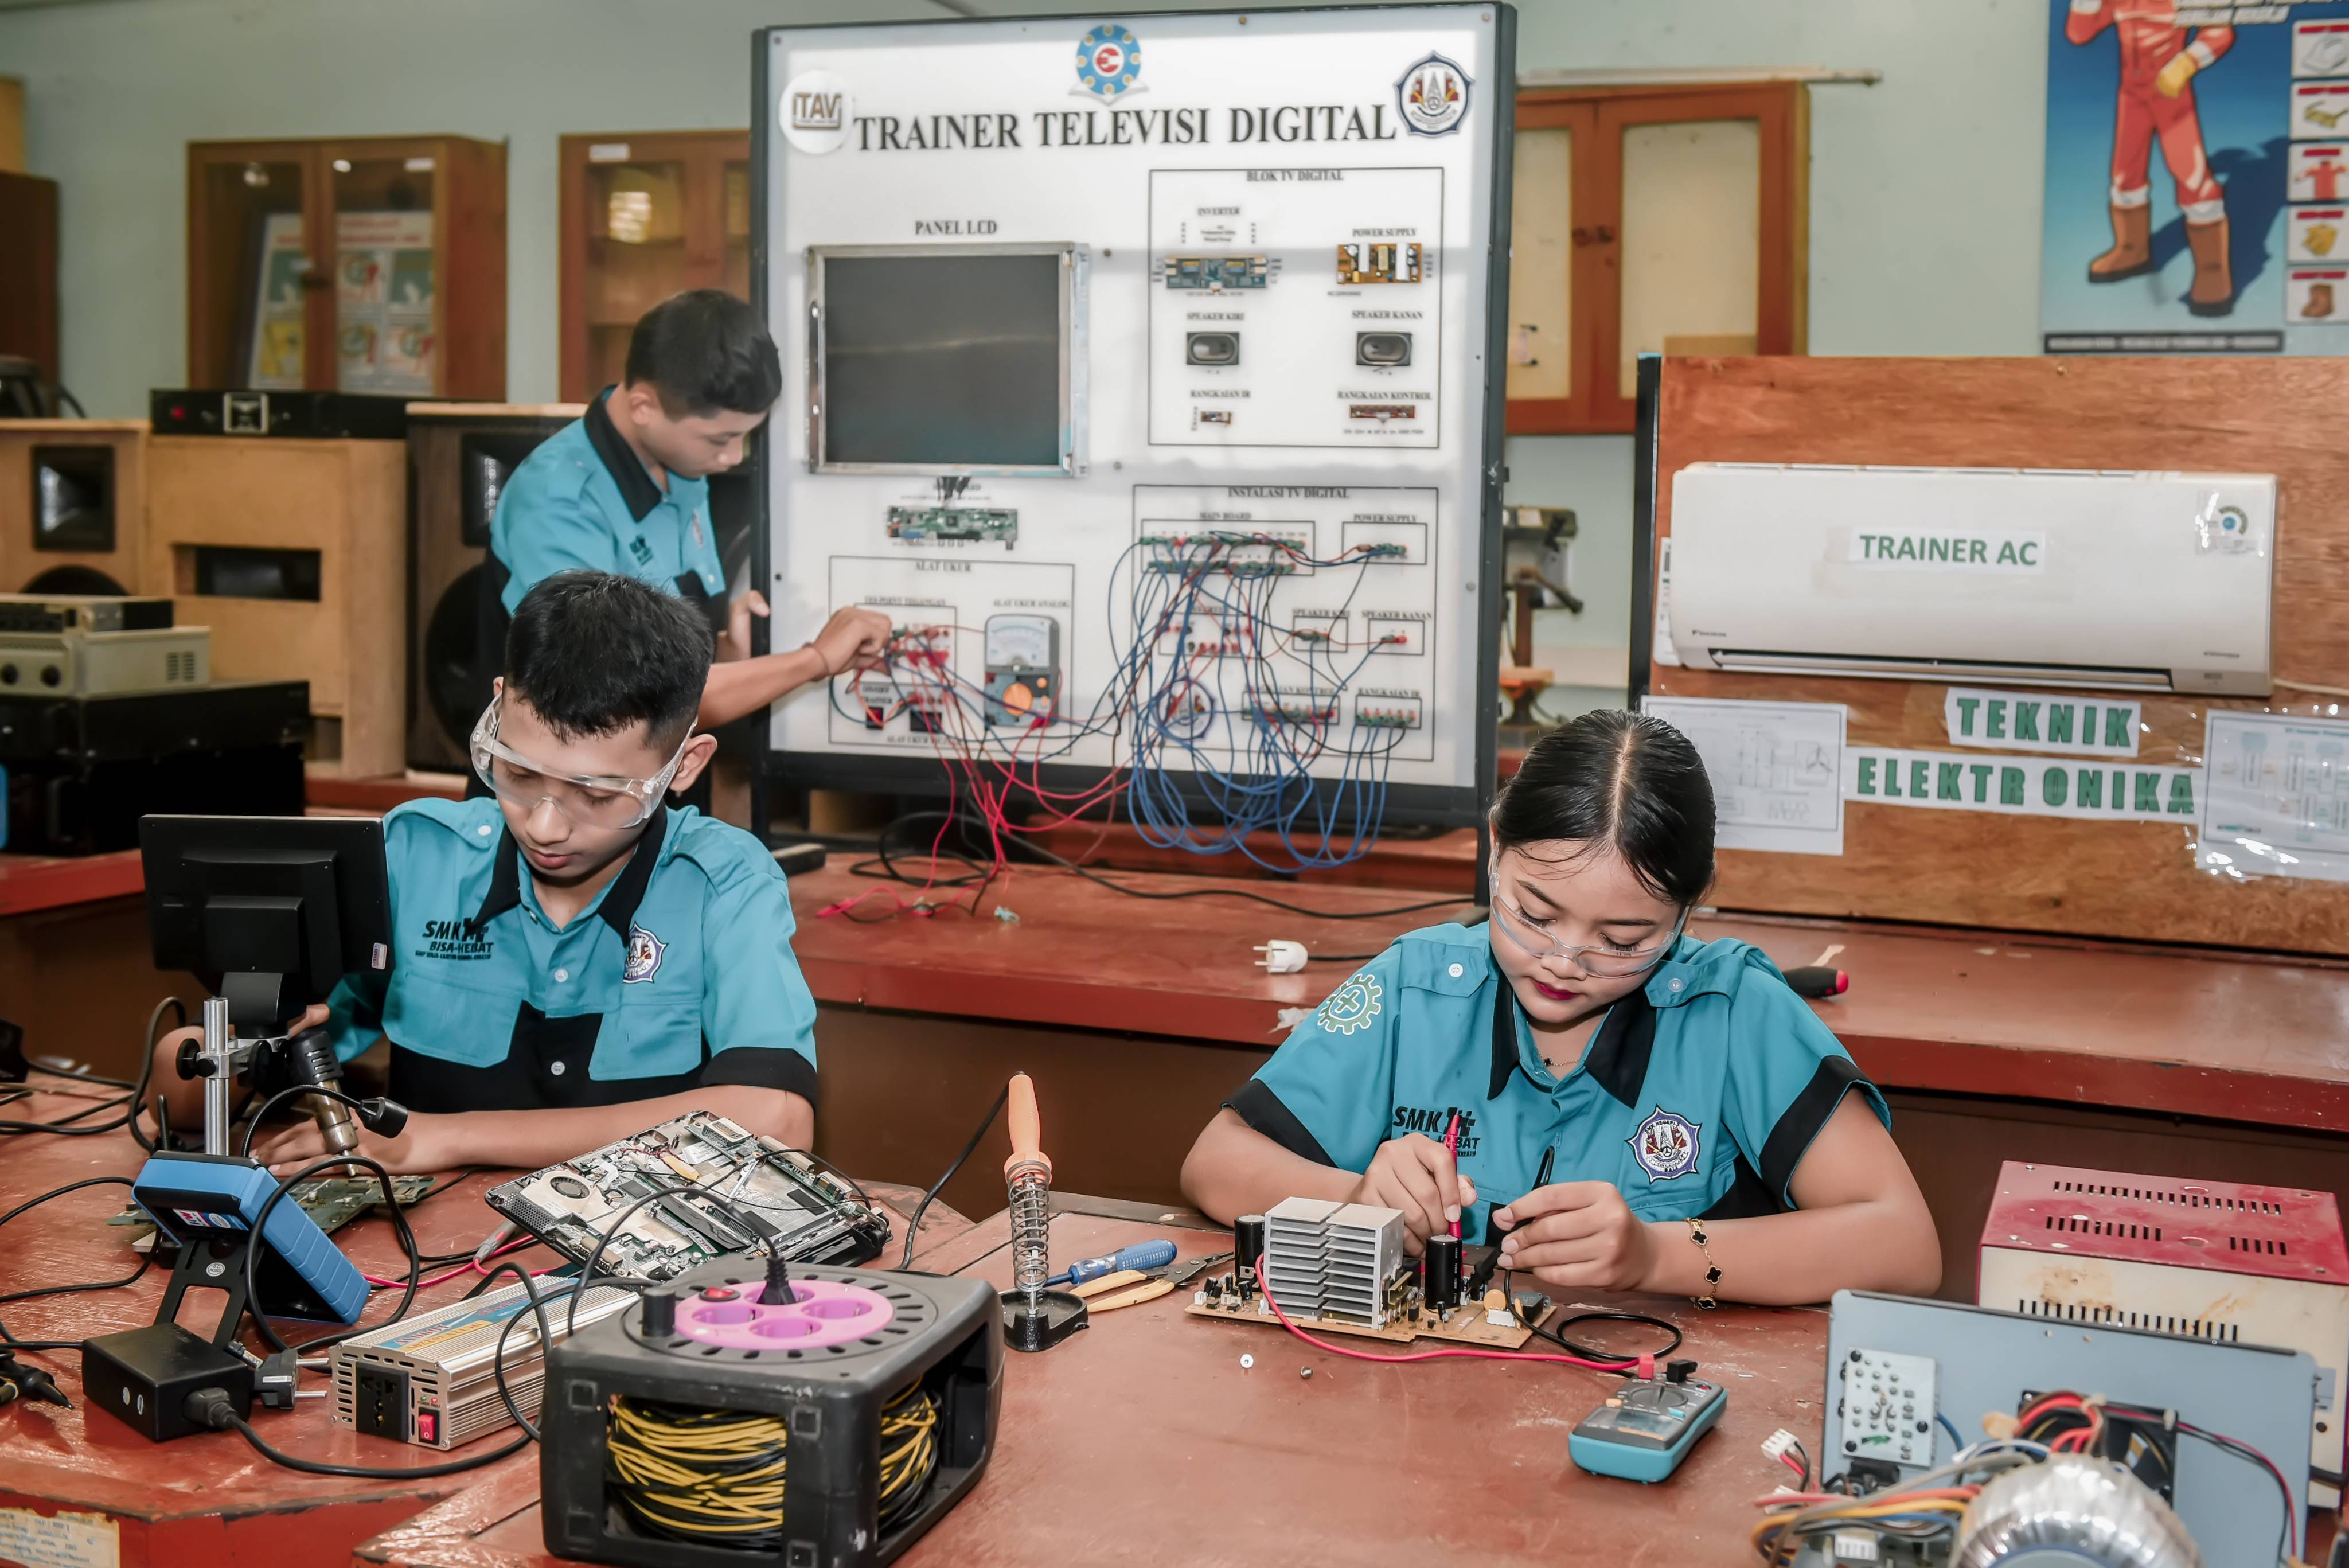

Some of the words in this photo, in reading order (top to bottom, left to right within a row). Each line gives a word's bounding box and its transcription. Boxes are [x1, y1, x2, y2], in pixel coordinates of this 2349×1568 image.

[854, 114, 1022, 151] TRAINER
[1034, 108, 1208, 147] TELEVISI
[1229, 104, 1397, 143] DIGITAL
[1247, 171, 1278, 182] BLOK
[1281, 171, 1295, 181] TV
[1298, 170, 1344, 181] DIGITAL
[915, 221, 963, 235] PANEL
[967, 220, 997, 235] LCD
[1352, 229, 1383, 237] POWER
[1386, 228, 1417, 236] SUPPLY
[1352, 311, 1390, 319] SPEAKER
[1392, 311, 1423, 319] KANAN
[1228, 487, 1284, 498] INSTALASI
[1304, 487, 1349, 498] DIGITAL
[1860, 535, 1987, 564] TRAINER
[1997, 540, 2038, 567] AC
[1957, 698, 2132, 747] TEKNIK
[1859, 757, 2194, 814] ELEKTRONIKA
[422, 920, 461, 940] SMK
[1393, 1106, 1443, 1132] SMK
